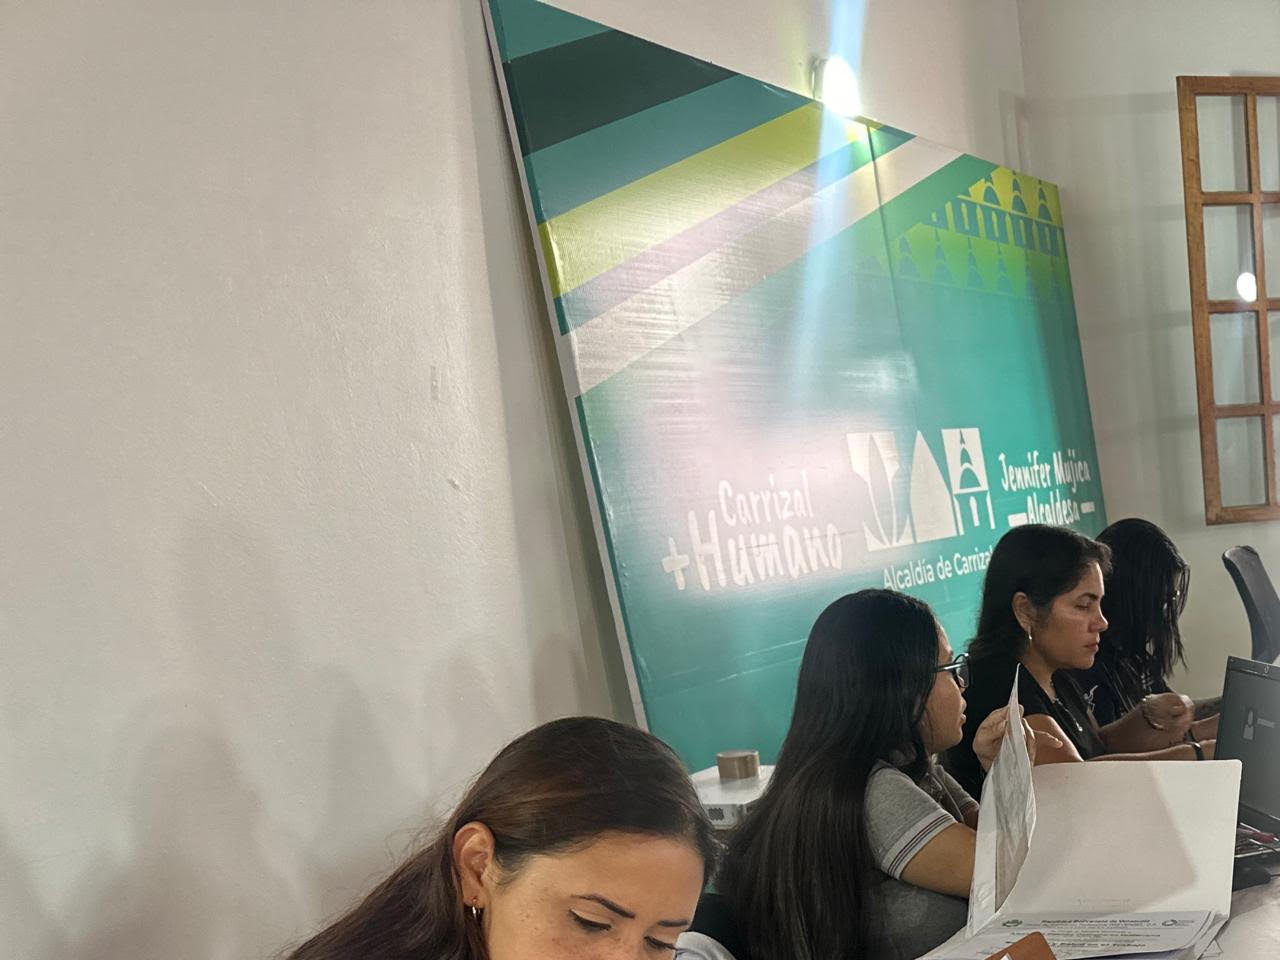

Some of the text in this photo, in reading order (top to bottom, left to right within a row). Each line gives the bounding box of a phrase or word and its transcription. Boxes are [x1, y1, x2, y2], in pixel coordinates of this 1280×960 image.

[998, 450, 1052, 492] Jennifer
[717, 469, 814, 526] Carrizal
[1026, 488, 1080, 526] Alcaldesa
[884, 558, 935, 591] Alcaldía
[936, 554, 953, 580] de
